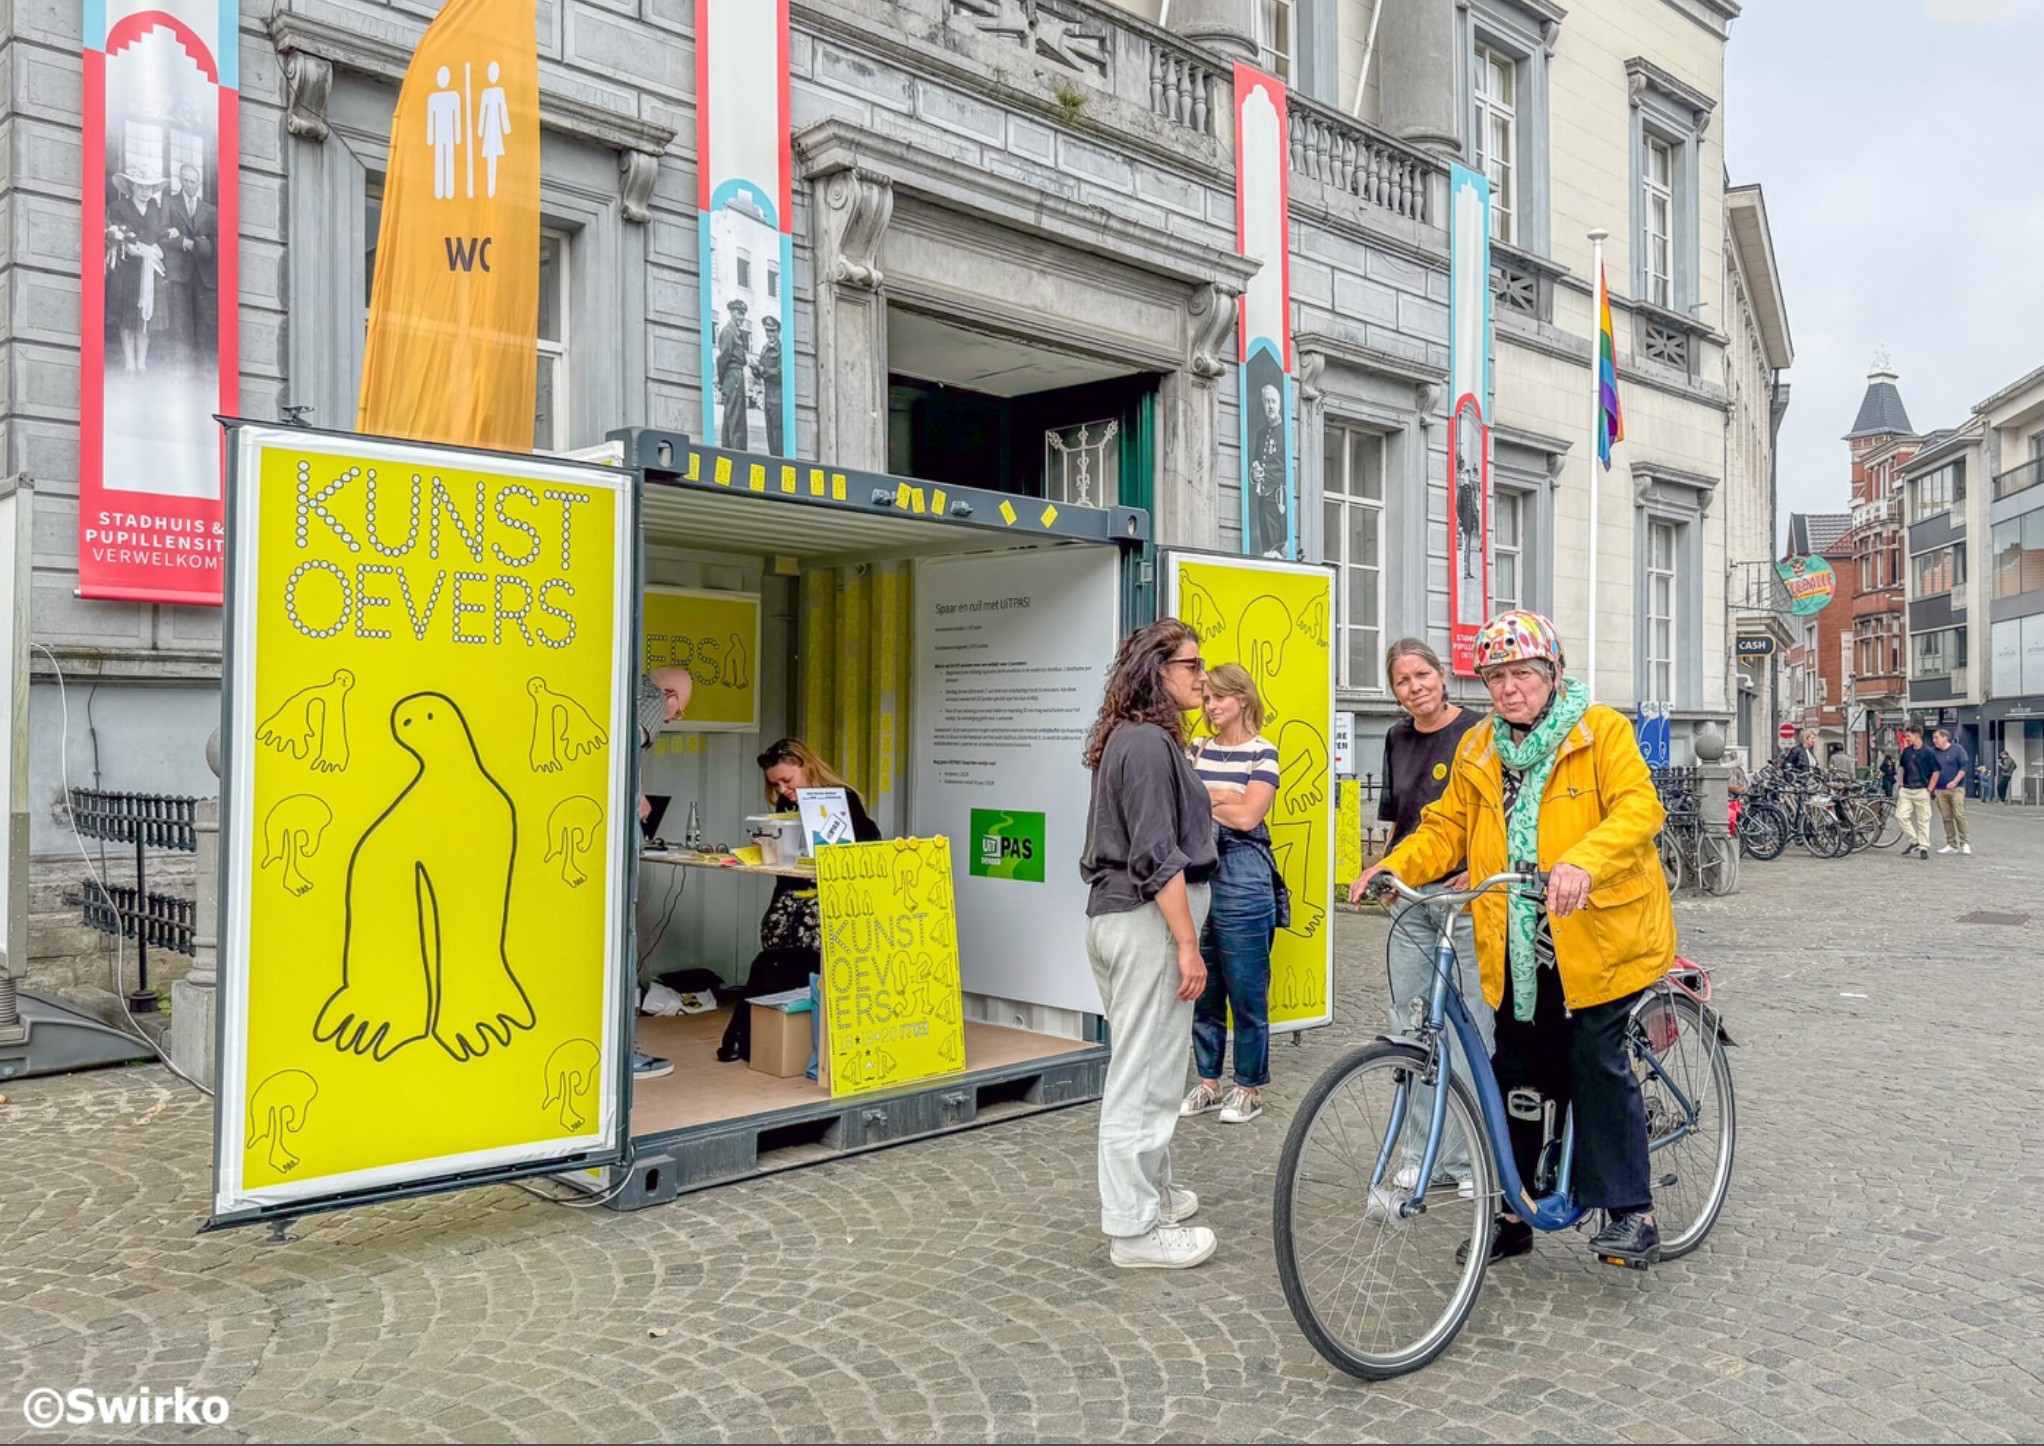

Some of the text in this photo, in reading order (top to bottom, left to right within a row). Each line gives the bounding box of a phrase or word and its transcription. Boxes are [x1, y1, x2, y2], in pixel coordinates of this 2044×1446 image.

[444, 237, 492, 273] WC
[98, 511, 224, 535] STADHUIS &
[295, 460, 590, 571] KUNST
[284, 559, 578, 650] OEVERS
[935, 602, 958, 616] Spaar
[958, 603, 968, 614] en
[969, 600, 983, 612] ruil
[984, 599, 999, 611] met
[1738, 640, 1766, 650] CASH
[1001, 836, 1033, 860] PAS
[828, 912, 929, 957] KUNST
[831, 953, 892, 994] OEV
[835, 989, 894, 1031] ERS
